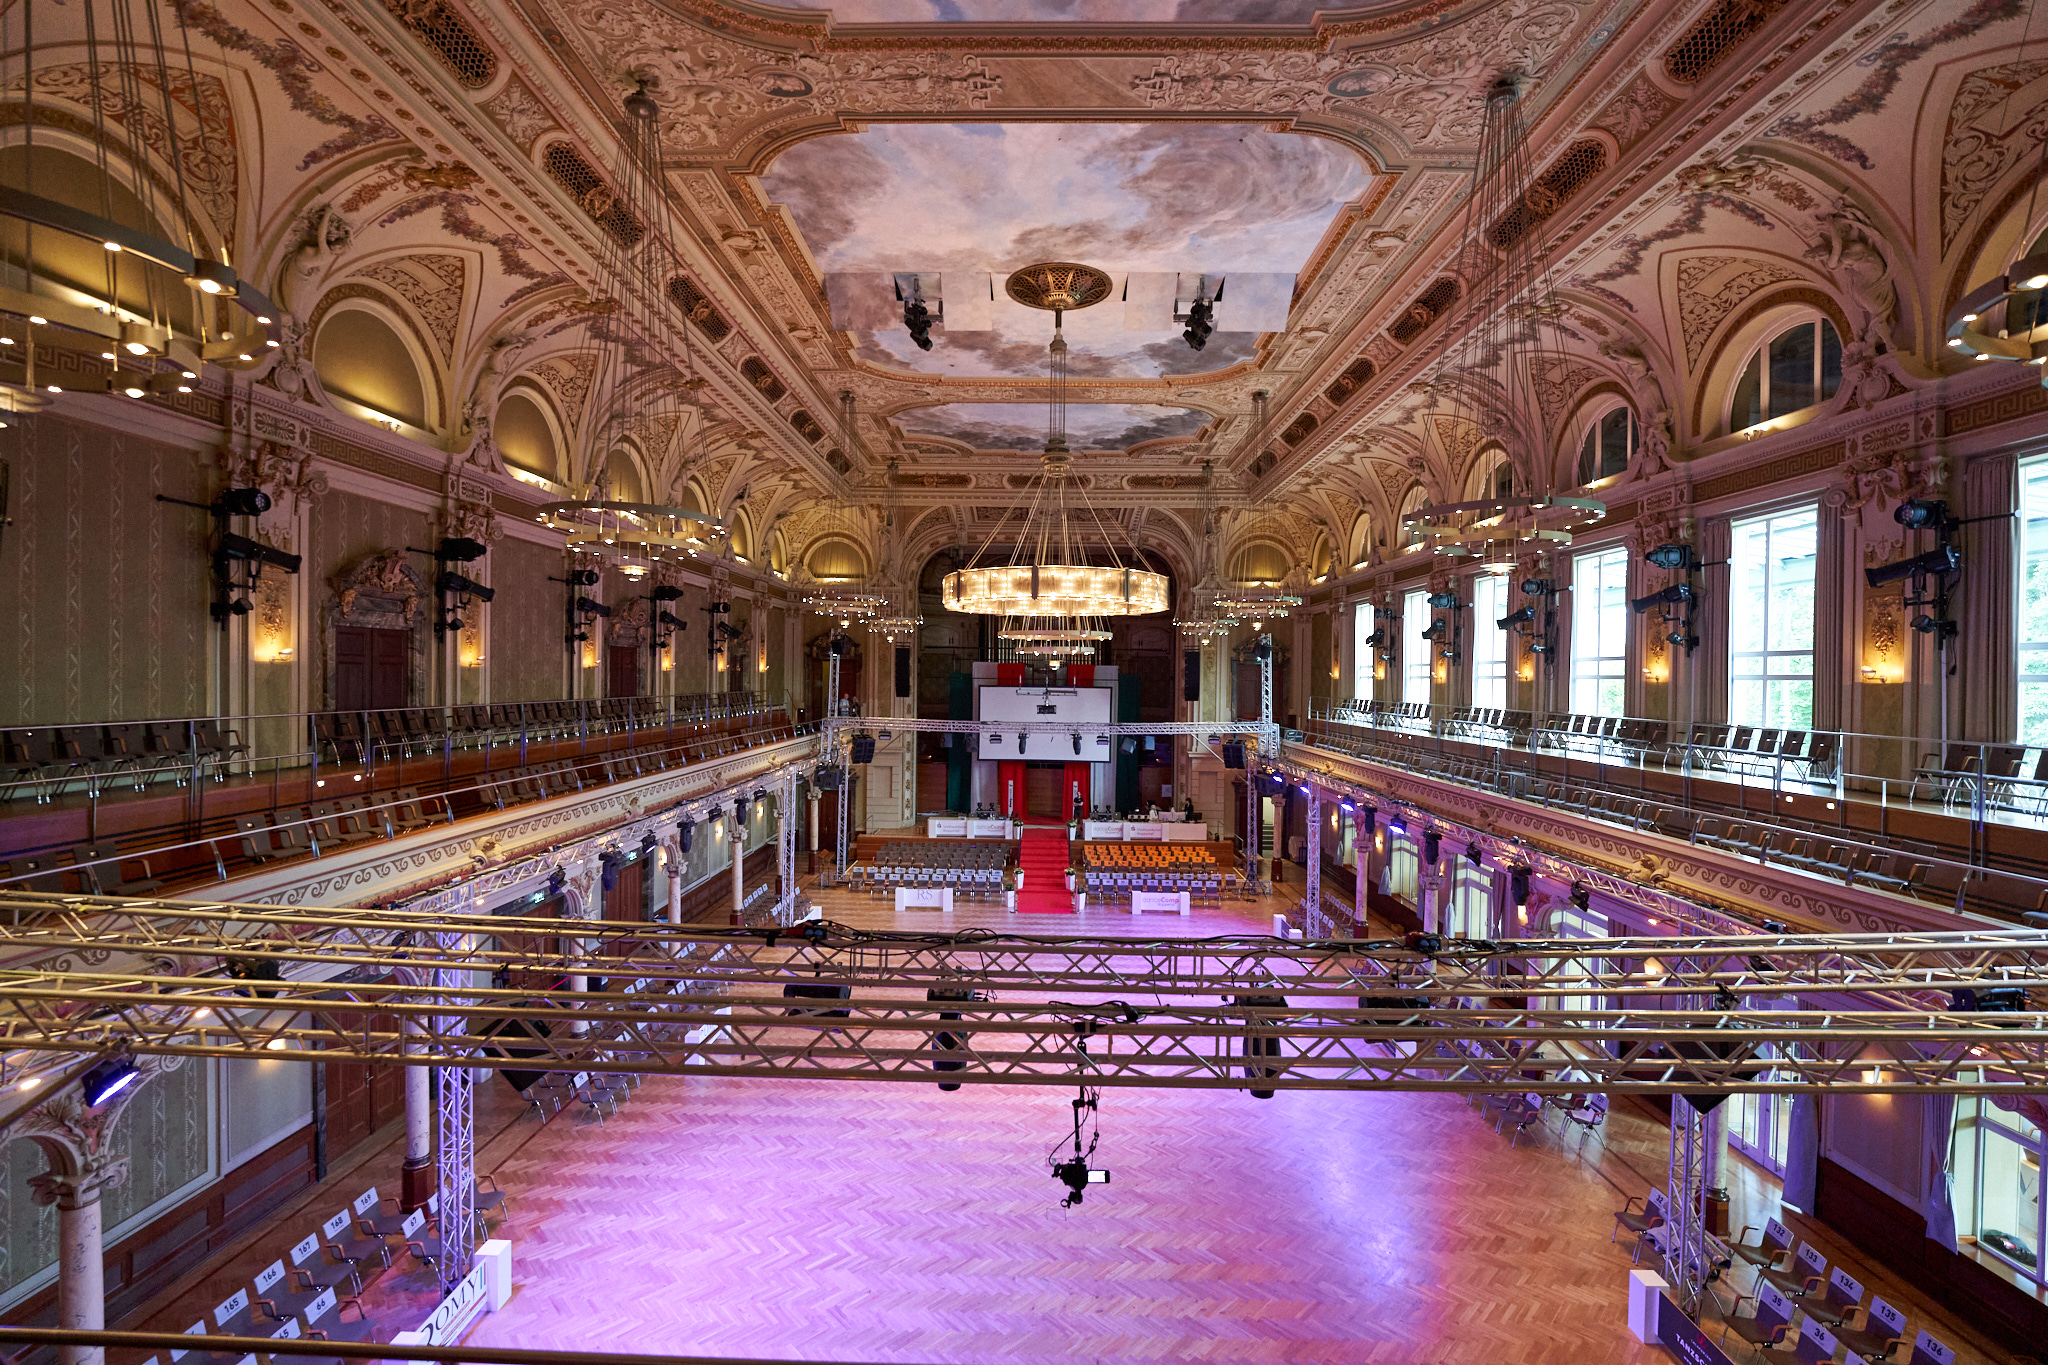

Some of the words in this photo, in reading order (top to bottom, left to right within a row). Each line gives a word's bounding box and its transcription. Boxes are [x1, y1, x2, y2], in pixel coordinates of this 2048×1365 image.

[360, 1193, 372, 1206] 169
[331, 1216, 343, 1230] 168
[410, 1216, 417, 1227] 67
[1773, 1223, 1786, 1237] 132
[298, 1241, 311, 1255] 167
[1805, 1249, 1818, 1263] 133
[263, 1268, 277, 1282] 166
[1840, 1275, 1854, 1290] 134
[224, 1297, 240, 1313] 165
[316, 1299, 326, 1311] 66
[1771, 1294, 1783, 1307] 35
[1880, 1305, 1896, 1322] 135
[1814, 1328, 1825, 1341] 36
[1926, 1339, 1943, 1356] 136
